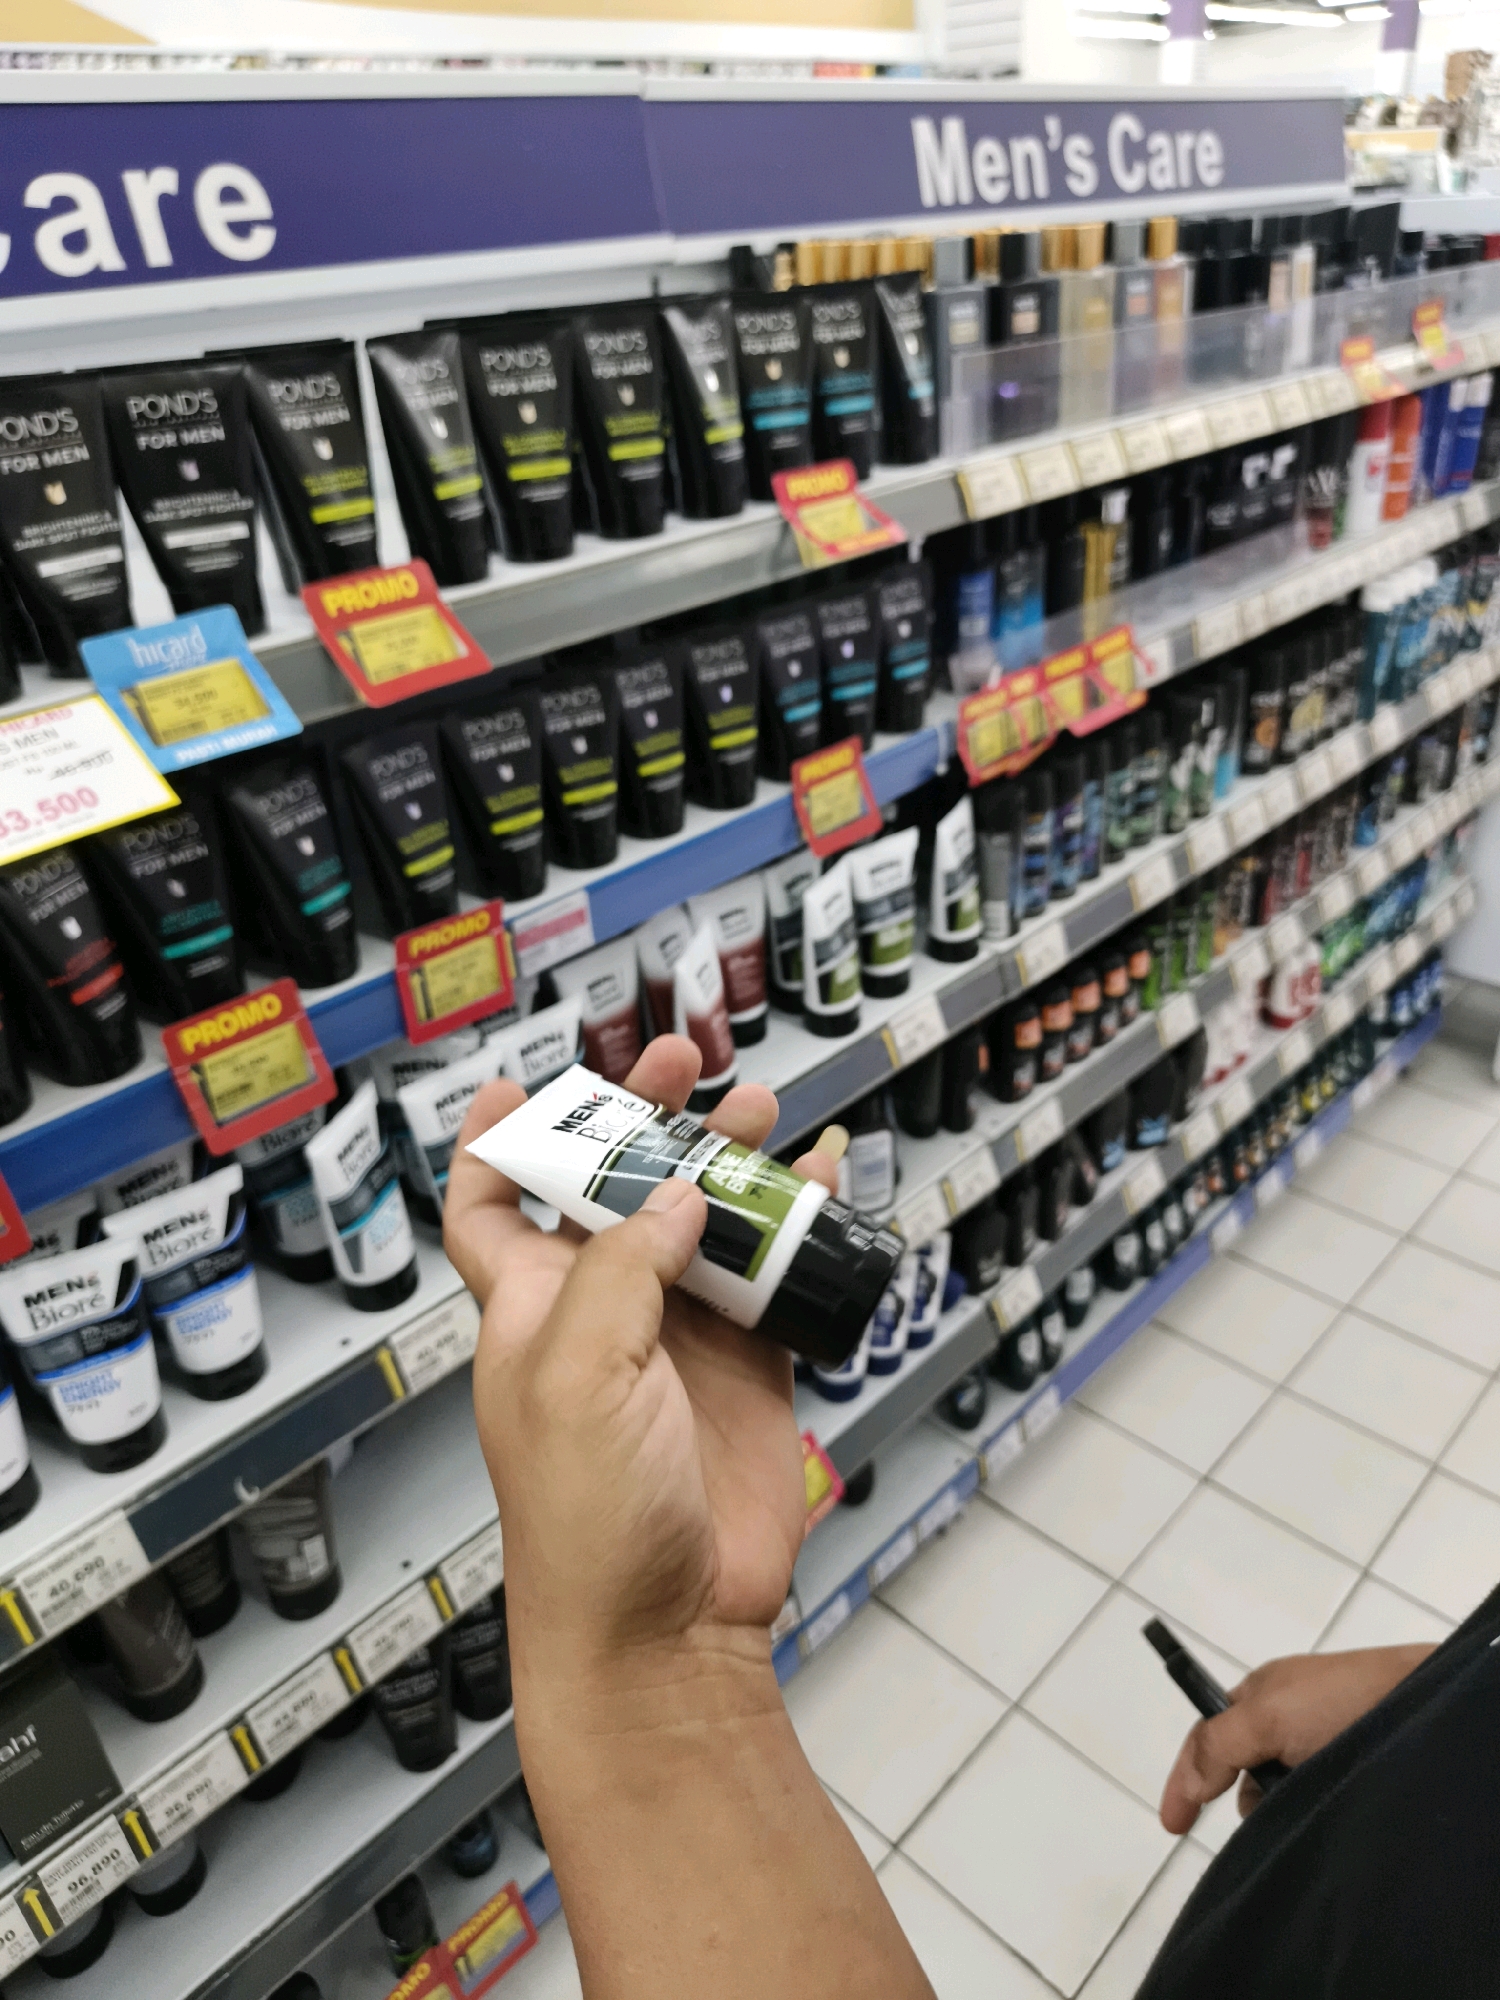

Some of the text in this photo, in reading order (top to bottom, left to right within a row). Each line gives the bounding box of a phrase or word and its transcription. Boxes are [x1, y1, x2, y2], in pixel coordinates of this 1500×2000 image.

[911, 113, 1226, 208] Men's Care
[0, 162, 277, 277] are
[0, 406, 79, 442] OND'S
[136, 422, 226, 451] FOR MEN
[0, 443, 91, 476] FOR MEN
[319, 569, 420, 619] PROMO
[13, 726, 60, 749] MEN
[408, 910, 491, 959] PROMO
[178, 992, 283, 1056] PROMO
[67, 1847, 121, 1893] 96,890
[448, 1891, 510, 1954] PROMO
